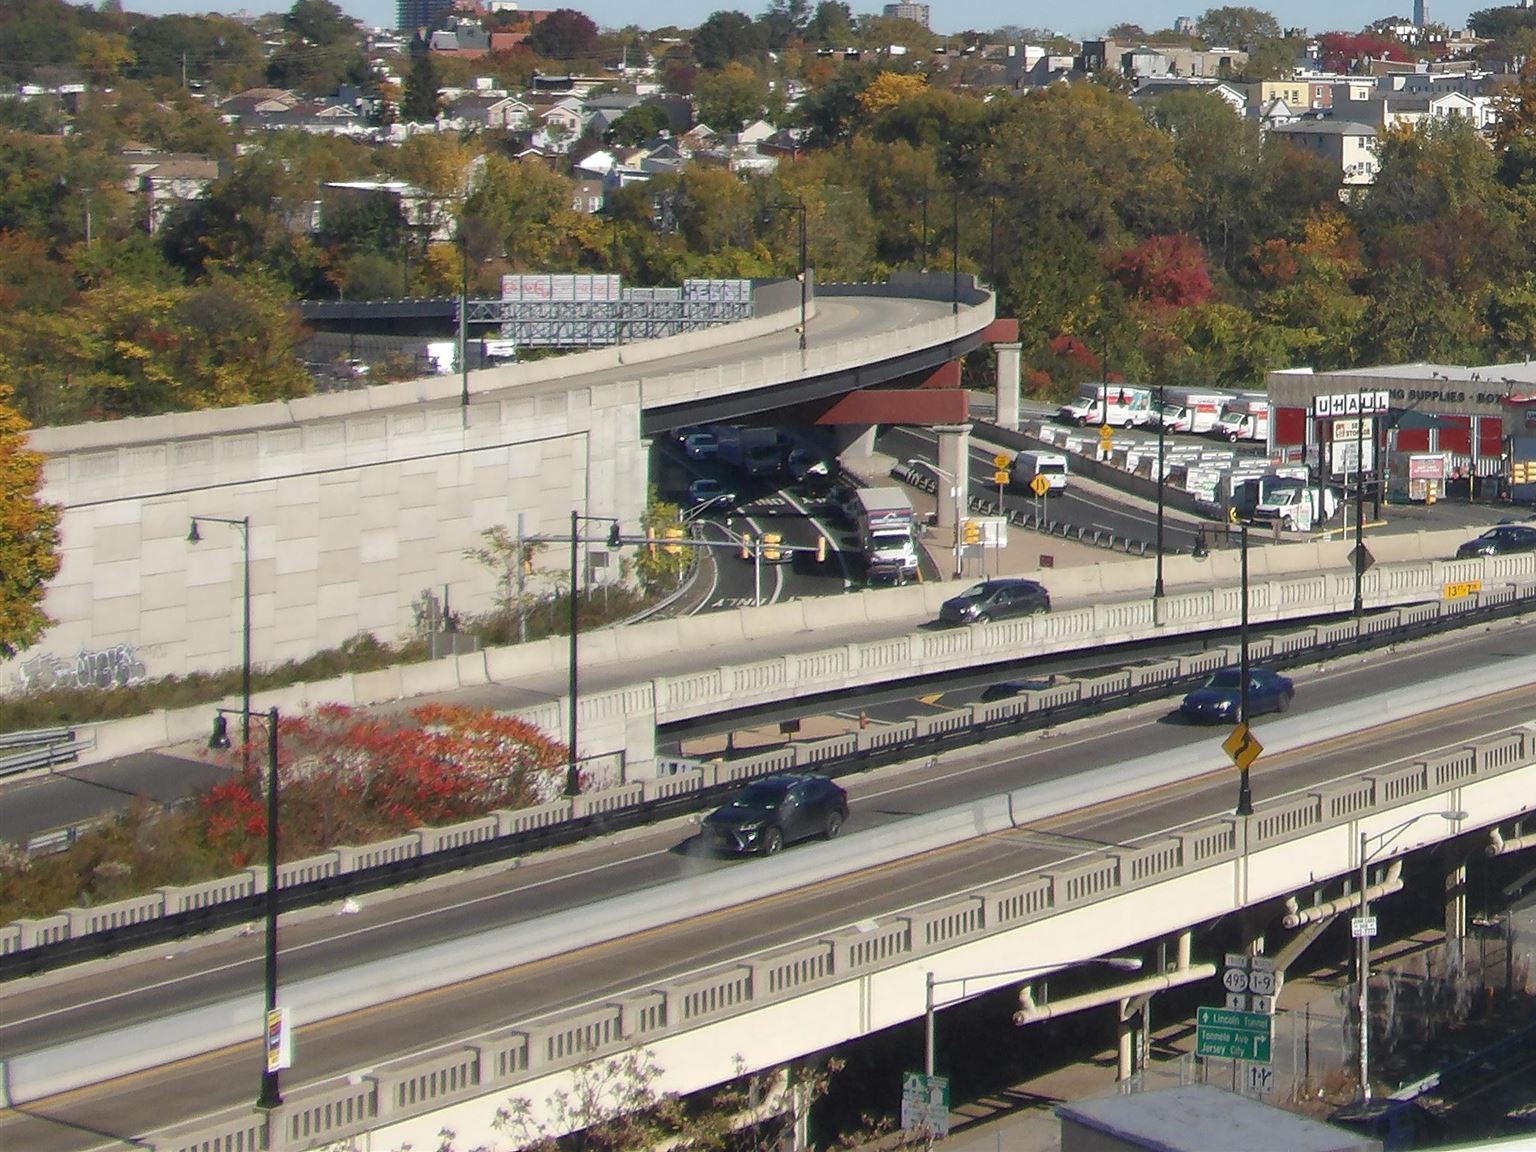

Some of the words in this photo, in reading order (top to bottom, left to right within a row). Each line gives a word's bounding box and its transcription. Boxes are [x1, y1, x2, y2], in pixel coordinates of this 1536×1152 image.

[1408, 389, 1465, 403] SUPPLIES
[1225, 974, 1246, 989] 495
[1254, 975, 1271, 990] 1-9
[1213, 1014, 1240, 1025] Lincoln
[1234, 1033, 1249, 1044] Ave
[1200, 1042, 1226, 1055] Jersey
[1230, 1046, 1245, 1057] City
